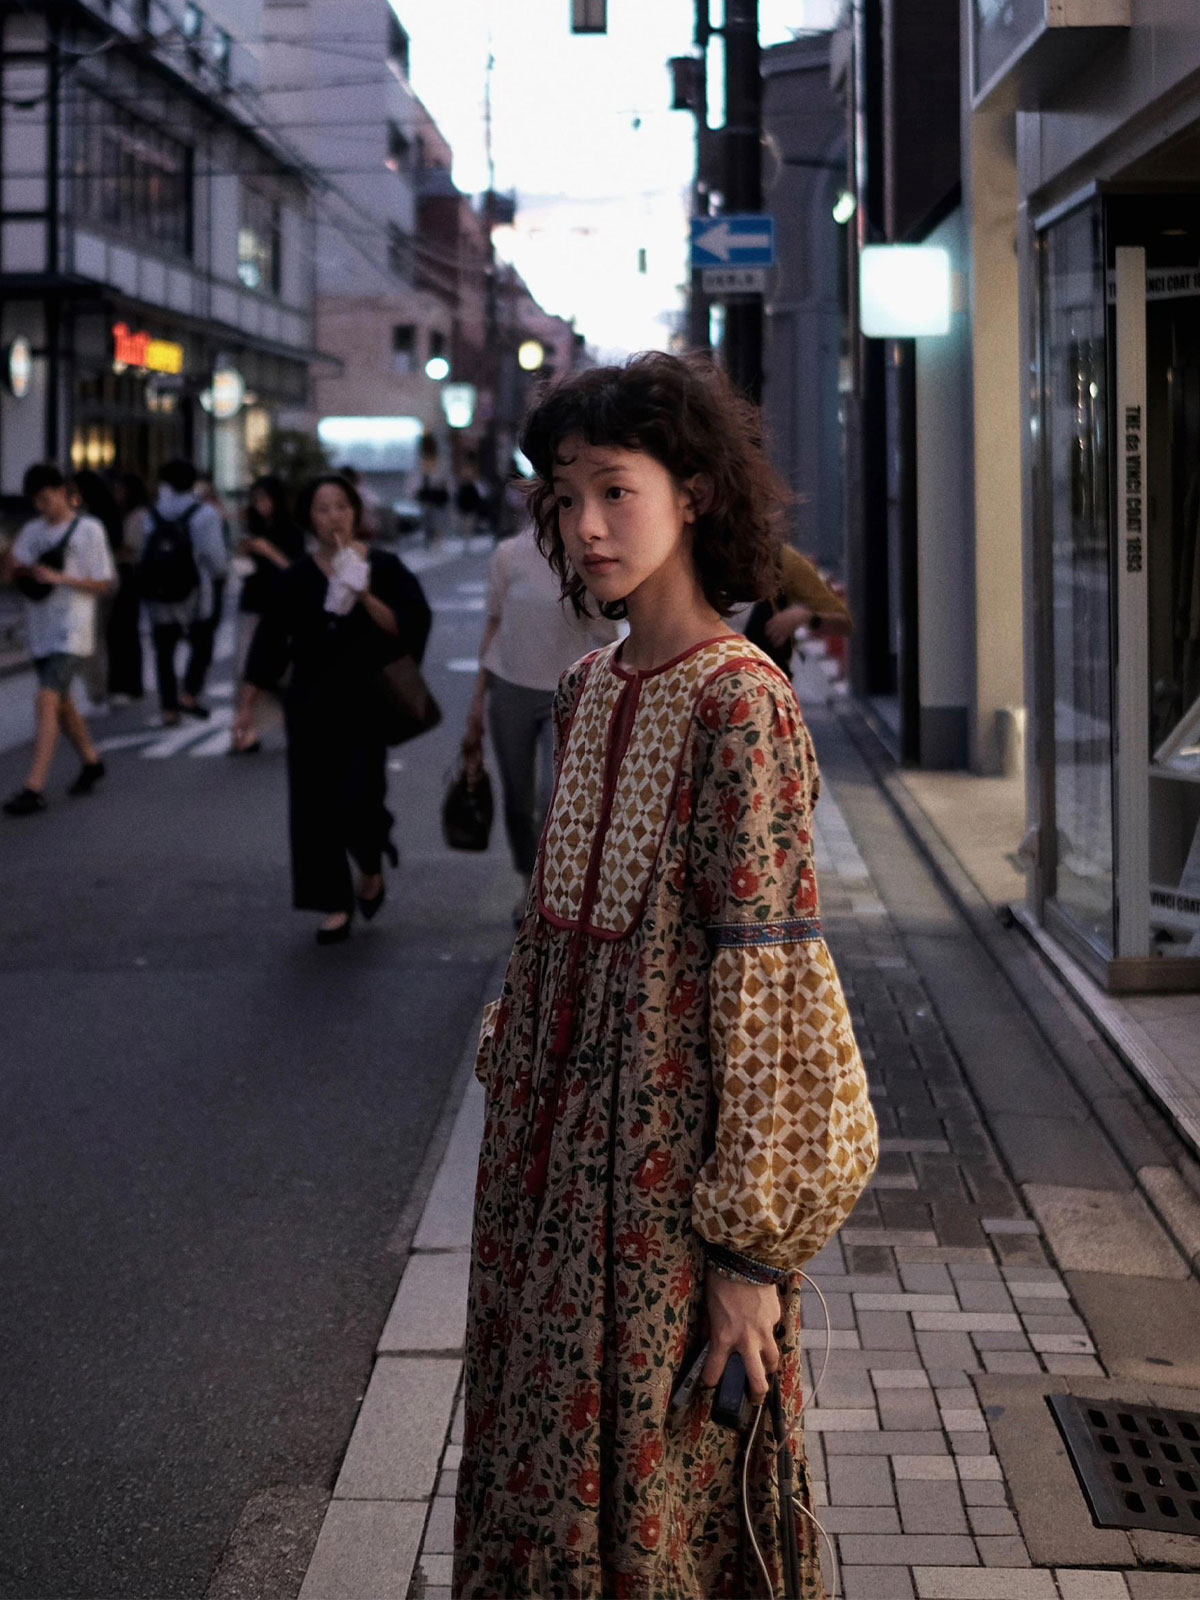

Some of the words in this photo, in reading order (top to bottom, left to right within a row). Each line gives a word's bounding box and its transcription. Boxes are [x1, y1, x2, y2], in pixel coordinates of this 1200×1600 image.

[1167, 273, 1191, 292] COAT
[1125, 405, 1141, 431] THE
[1125, 455, 1142, 494] VINCI
[1125, 497, 1142, 534] COAT
